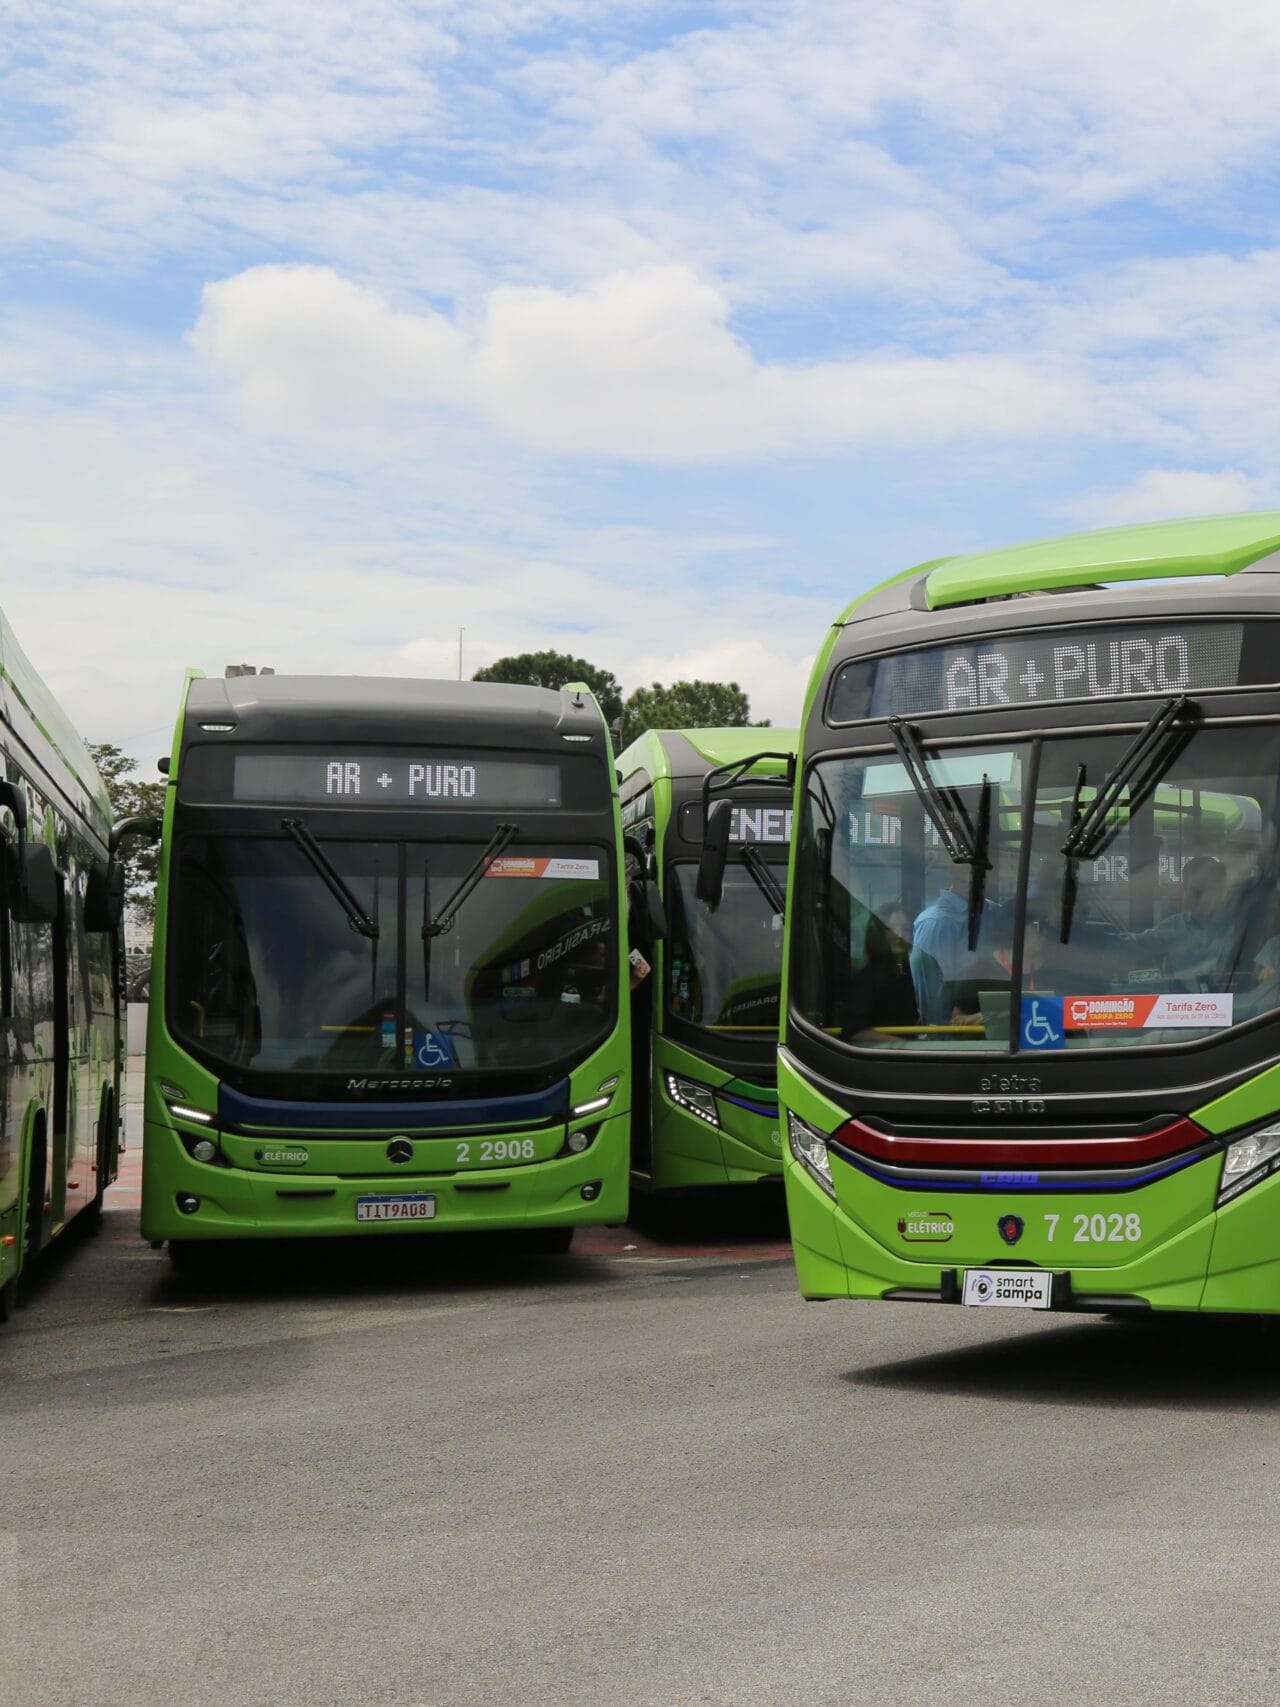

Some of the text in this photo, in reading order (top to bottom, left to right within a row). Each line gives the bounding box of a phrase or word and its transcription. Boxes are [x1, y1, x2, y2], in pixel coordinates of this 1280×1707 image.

[946, 635, 1188, 711] AR + PURO
[326, 762, 476, 797] AR + PURO
[1089, 998, 1135, 1013] DOMINGÃO
[1166, 1001, 1217, 1012] Tarifa Zero
[347, 1077, 453, 1090] Marcopolo
[264, 1150, 309, 1161] ELÉTRICO
[456, 1140, 535, 1163] 2 2908
[908, 1220, 954, 1234] ELÉTRICO
[1043, 1212, 1142, 1243] 7 2028
[996, 1275, 1035, 1289] smart
[995, 1287, 1043, 1303] sampa
